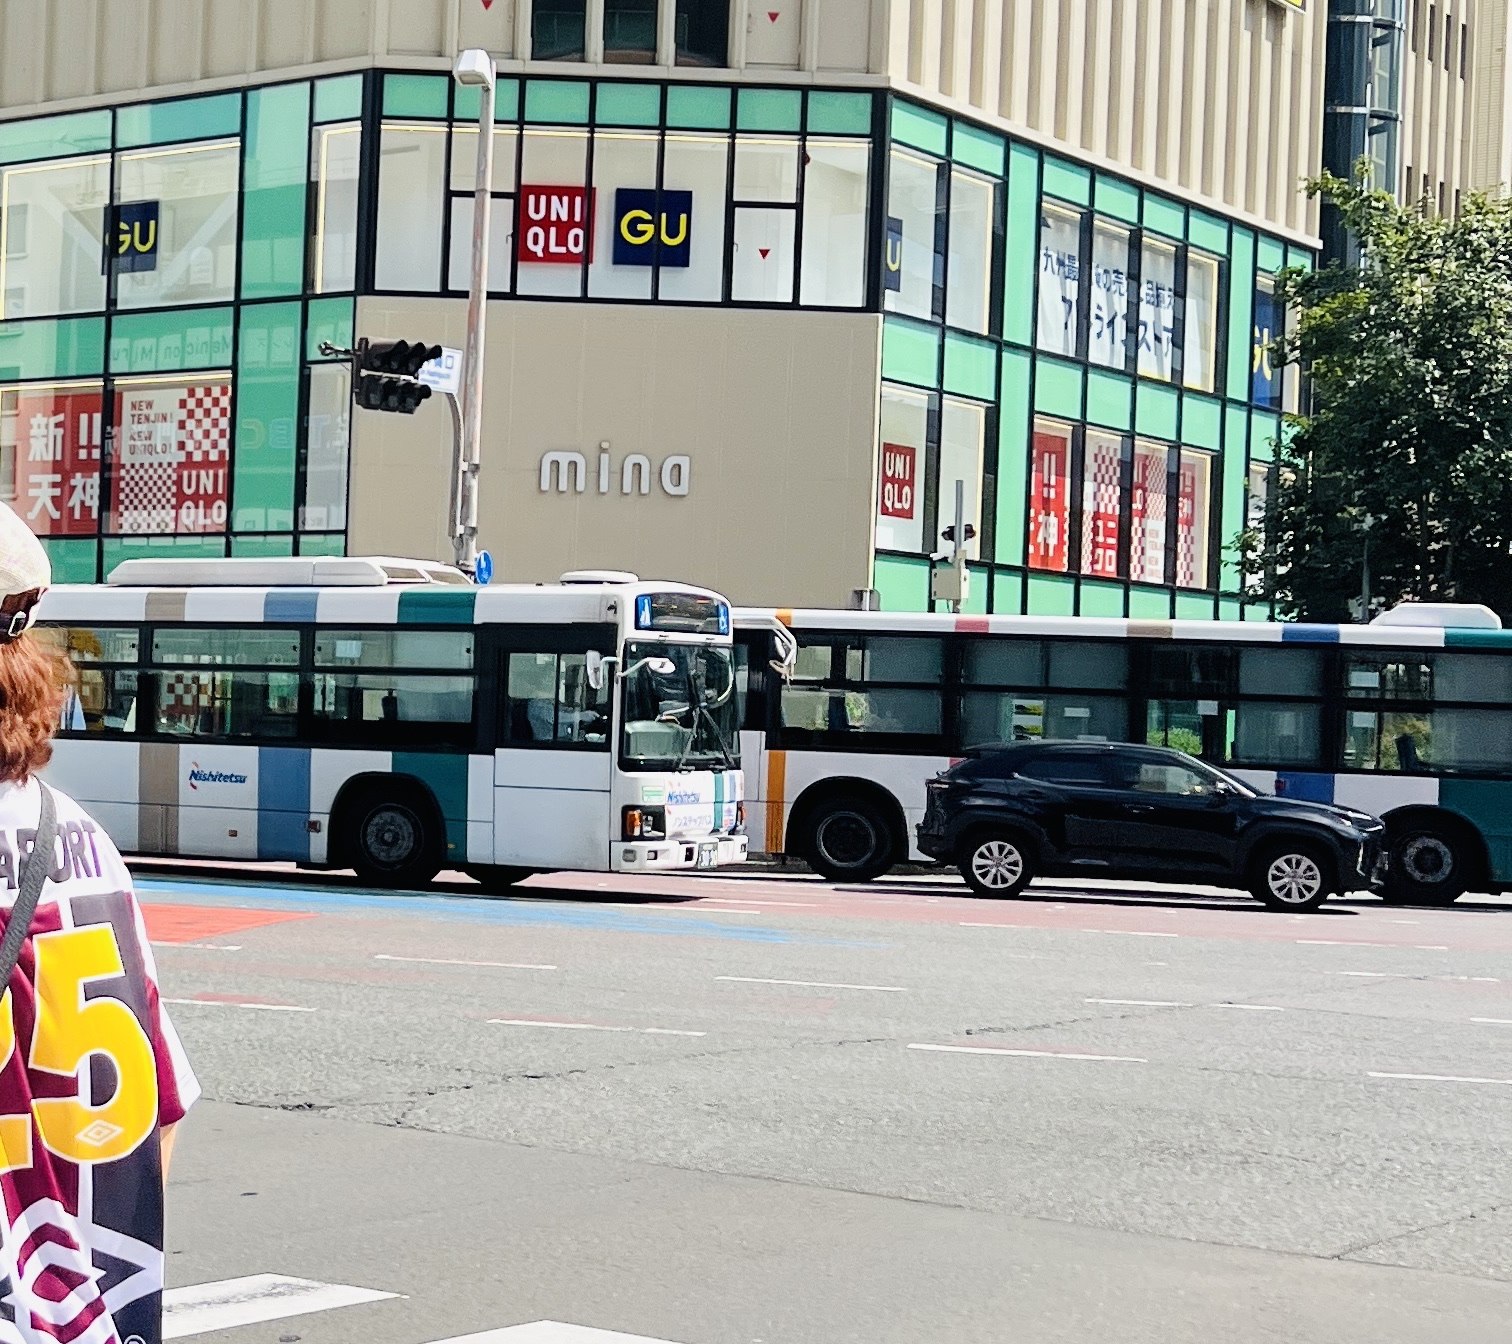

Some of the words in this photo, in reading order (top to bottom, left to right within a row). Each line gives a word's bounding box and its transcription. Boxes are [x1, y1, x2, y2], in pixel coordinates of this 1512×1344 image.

[528, 194, 581, 221] UNI
[526, 226, 585, 257] QLO
[619, 209, 687, 246] GU
[130, 400, 155, 412] NEW
[130, 413, 174, 425] TENJIN!
[540, 441, 690, 496] mina
[885, 452, 911, 481] UNI
[182, 469, 224, 495] UNI
[883, 482, 912, 512] QLO
[180, 500, 227, 529] QLO
[188, 769, 248, 784] Nishitetsu
